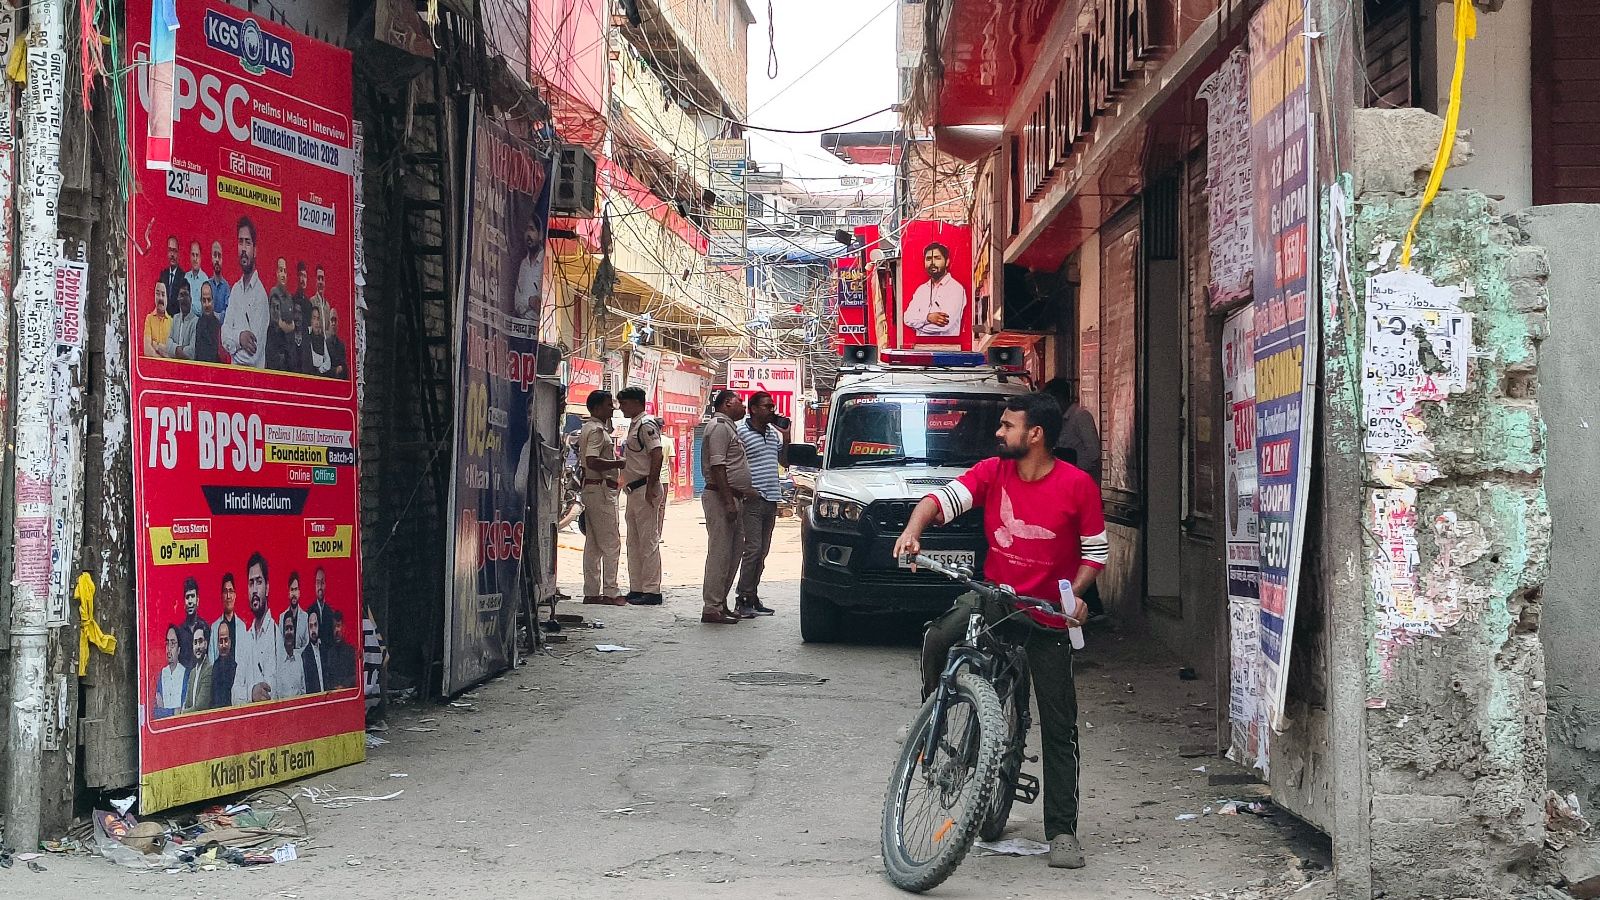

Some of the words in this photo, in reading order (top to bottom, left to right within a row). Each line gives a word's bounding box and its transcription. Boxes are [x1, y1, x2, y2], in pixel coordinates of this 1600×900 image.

[209, 16, 239, 52] KGS
[265, 39, 290, 69] IAS
[253, 99, 281, 120] Prelims
[286, 113, 308, 128] Mains
[313, 120, 346, 141] Interview
[252, 123, 296, 154] Foundation
[297, 135, 319, 161] Batch
[229, 152, 246, 174] हिंदी
[184, 184, 202, 198] April
[299, 206, 321, 225] 12:00
[322, 211, 335, 229] PM
[145, 402, 192, 470] 73rd
[198, 410, 264, 473] BPSC
[271, 446, 322, 463] Foundation
[854, 445, 897, 455] POLICE
[1262, 446, 1271, 474] 12
[1273, 442, 1291, 472] MAY
[289, 469, 311, 481] Online
[314, 469, 335, 481] Offline
[224, 493, 250, 510] Hindi
[253, 493, 291, 510] Medium
[190, 524, 208, 534] Starts
[311, 522, 325, 532] Time
[179, 544, 200, 561] April
[312, 541, 331, 553] 12:00
[333, 541, 343, 553] PM
[211, 763, 245, 788] Khan
[249, 755, 266, 780] Sir
[270, 752, 278, 775] &
[281, 750, 315, 773] Team
